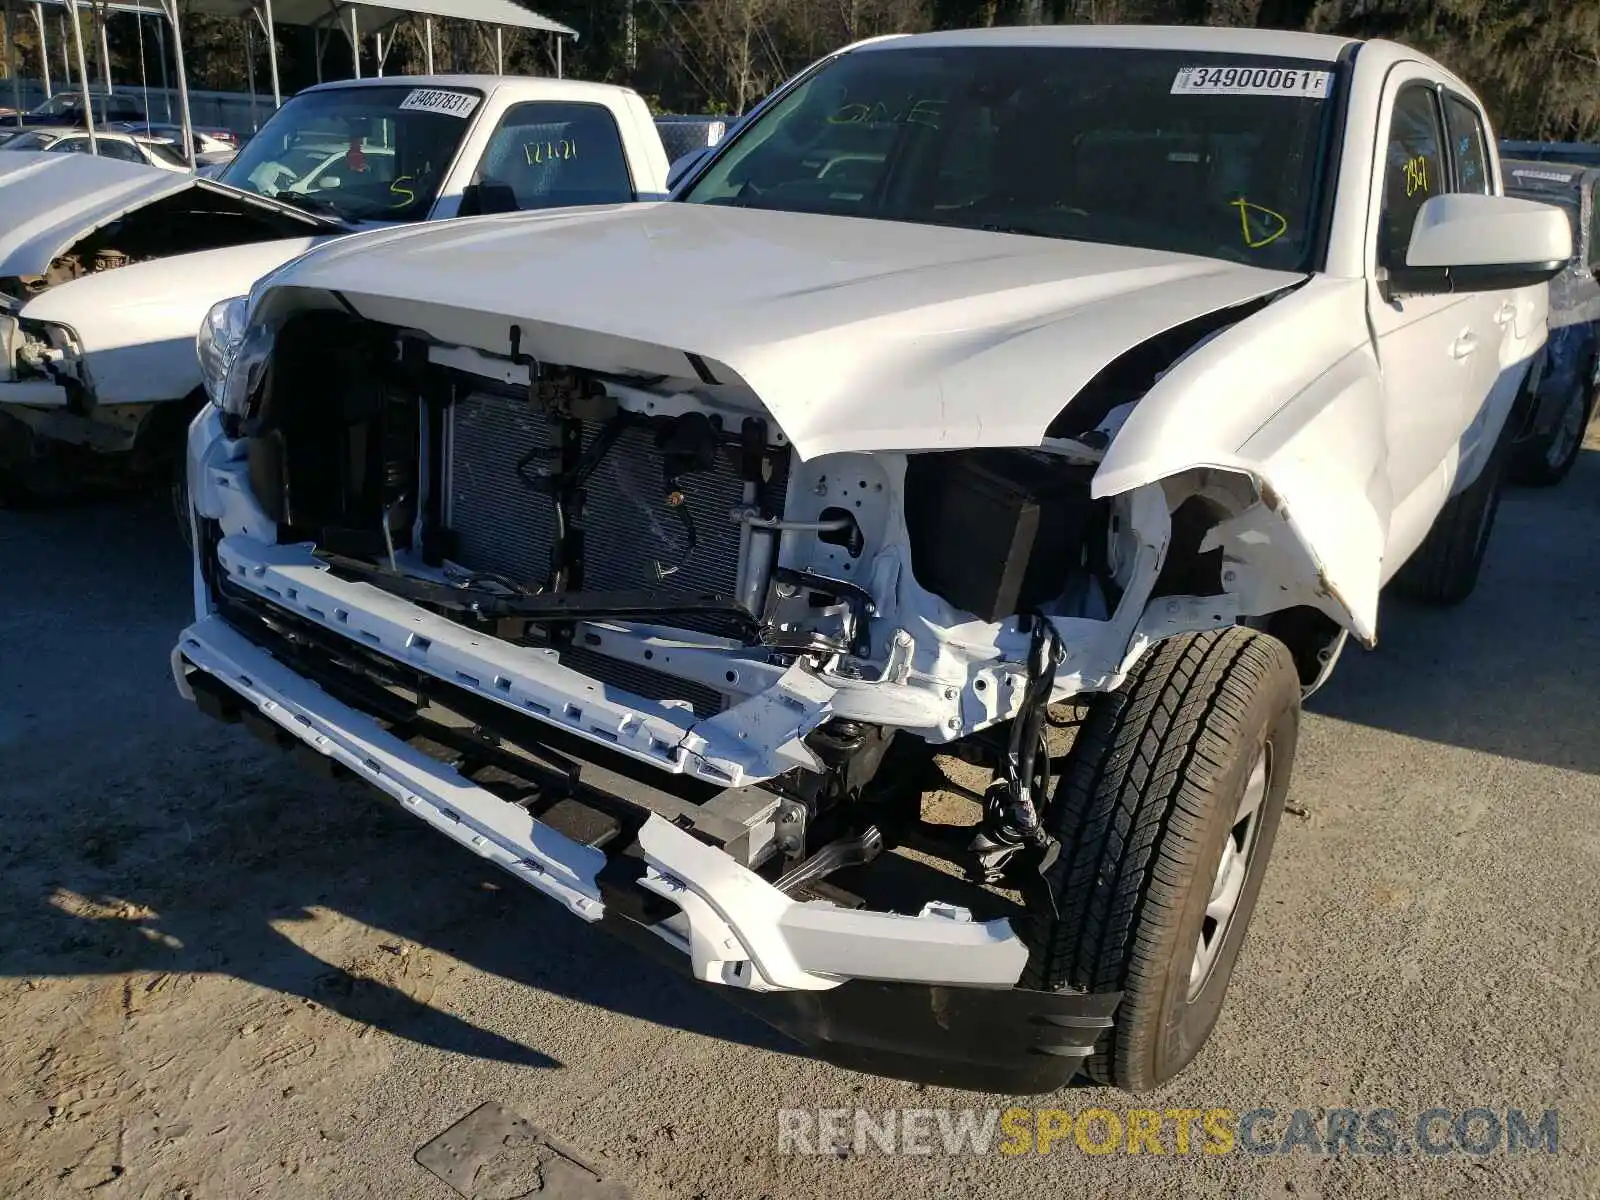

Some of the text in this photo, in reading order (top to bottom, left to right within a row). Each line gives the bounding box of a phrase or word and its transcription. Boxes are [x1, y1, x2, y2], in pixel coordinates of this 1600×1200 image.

[1193, 68, 1310, 89] 34900061
[410, 90, 468, 112] 34837831
[1229, 198, 1286, 247] D
